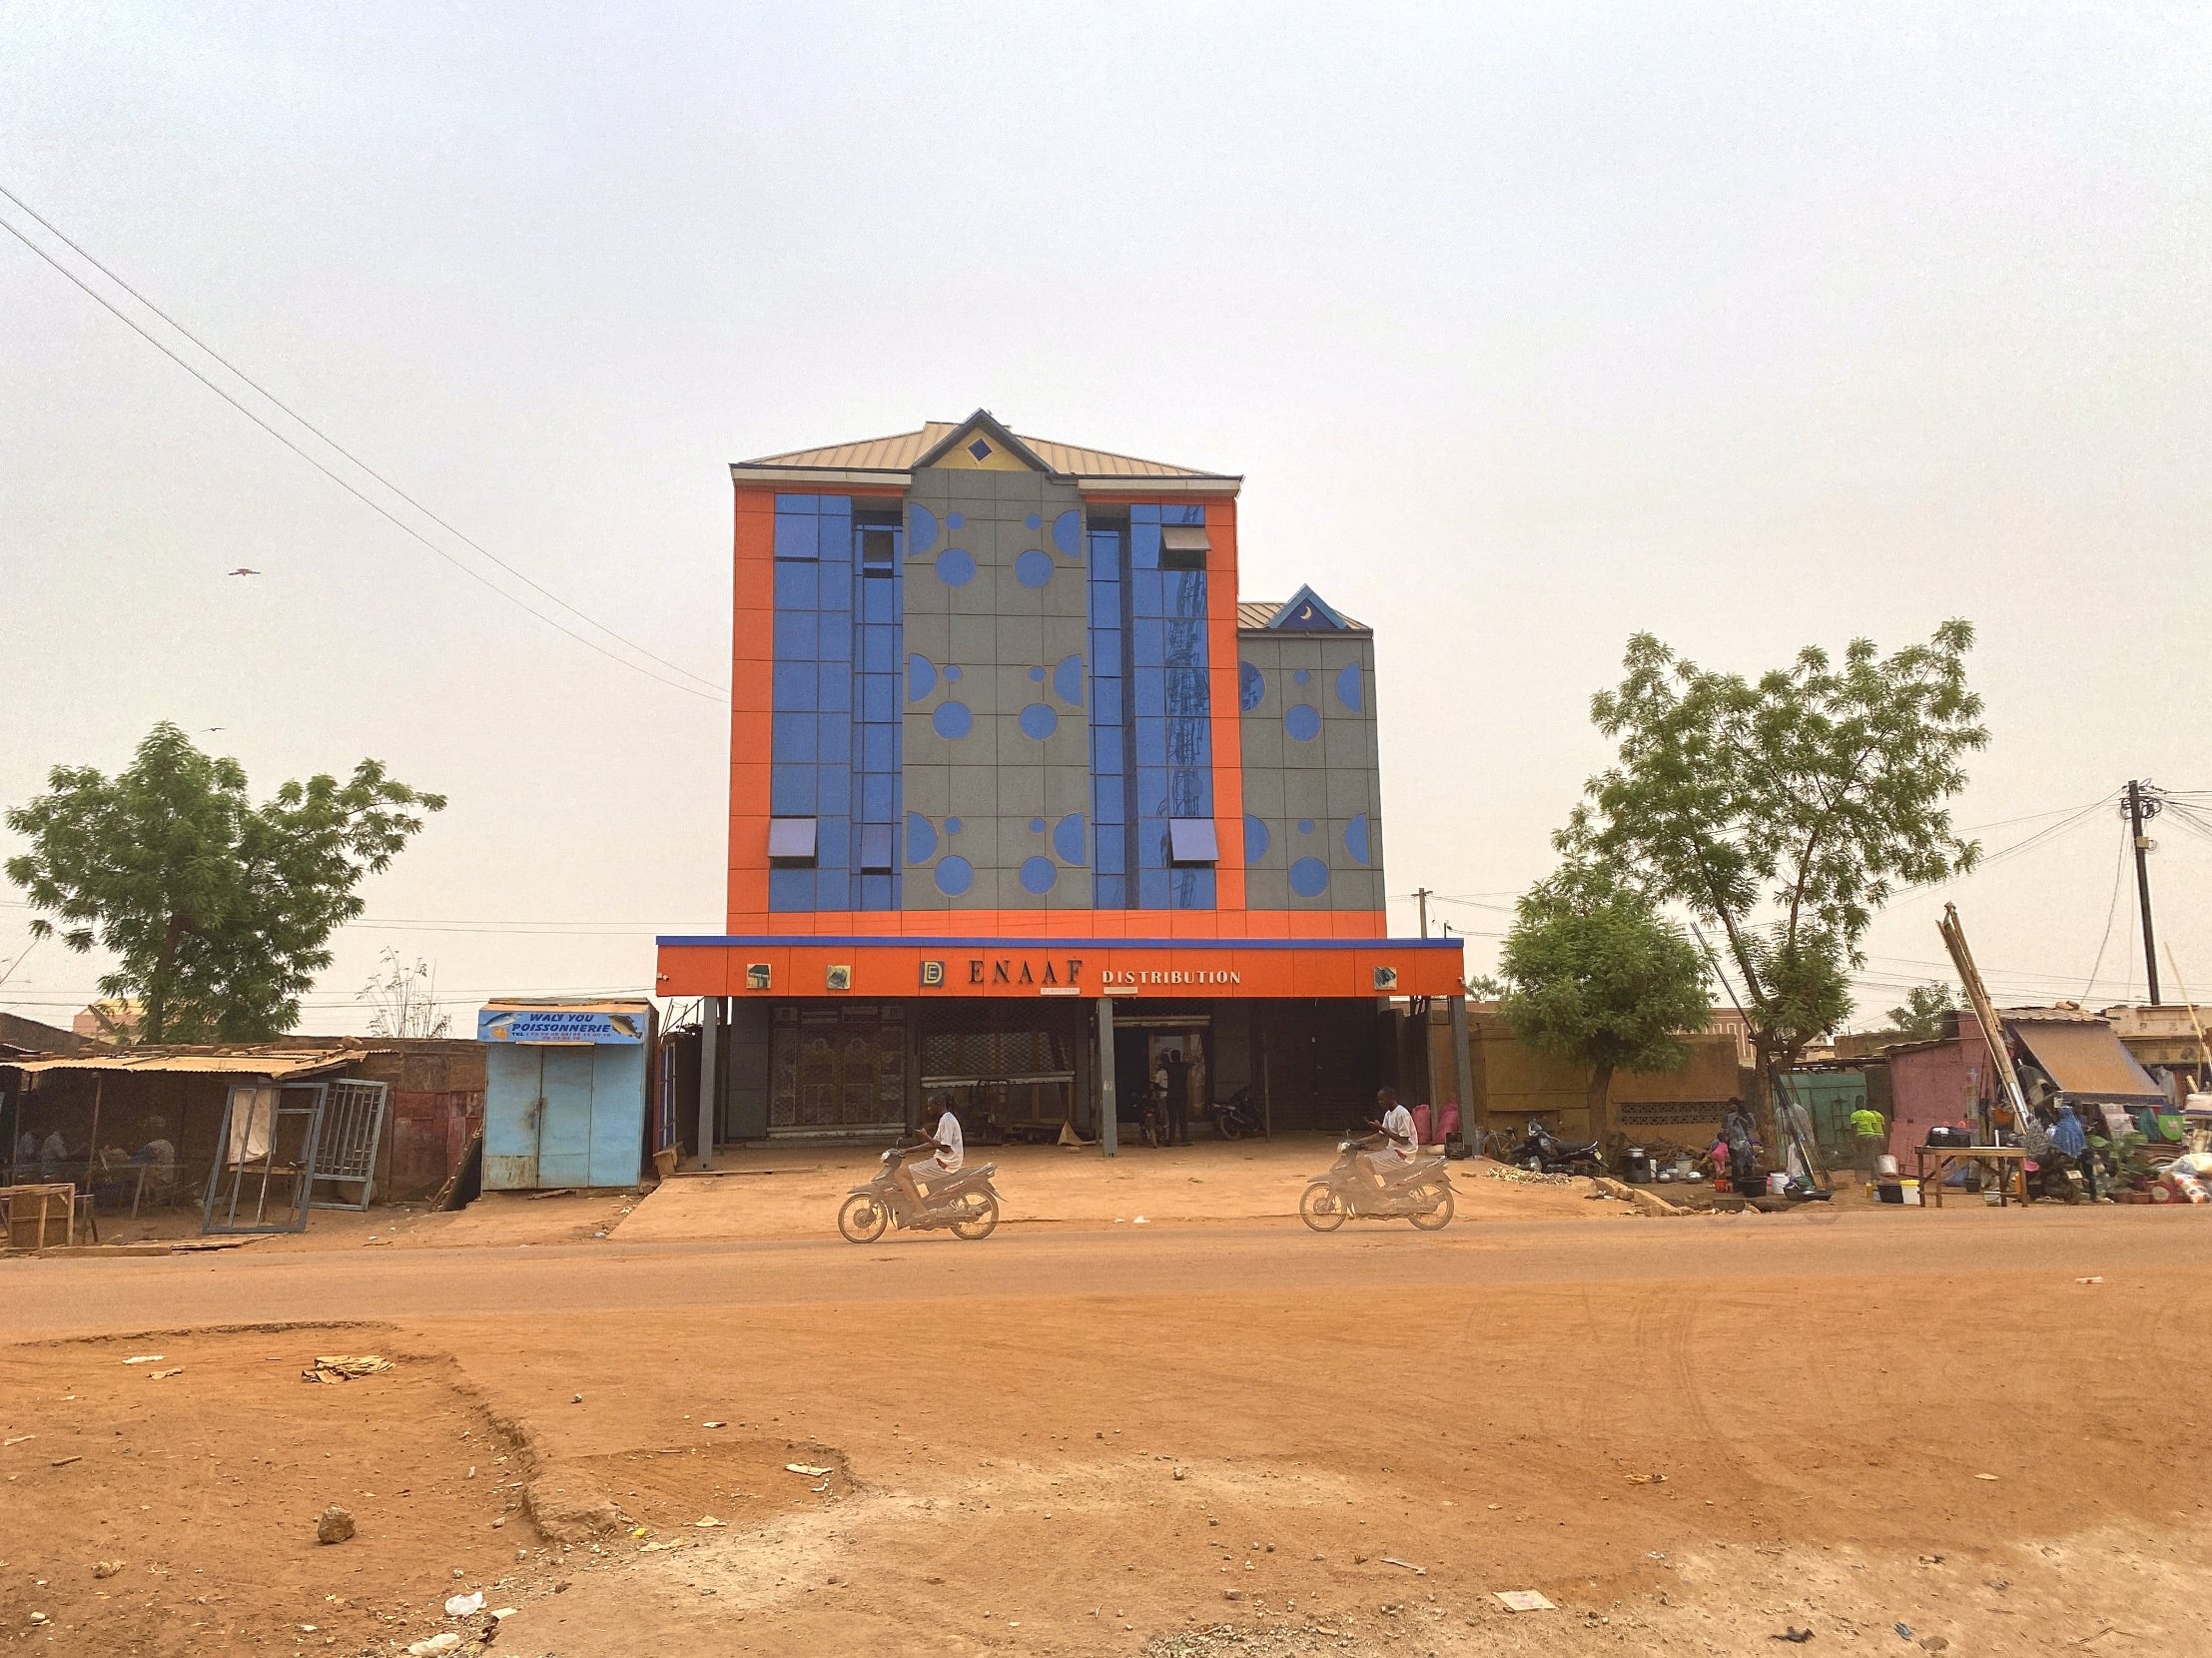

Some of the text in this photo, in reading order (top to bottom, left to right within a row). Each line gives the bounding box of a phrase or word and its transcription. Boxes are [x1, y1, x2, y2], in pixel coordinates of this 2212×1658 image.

[969, 959, 1241, 985] ENAAF DISTRIBUTION
[529, 1013, 595, 1023] WALY YOU
[511, 1023, 612, 1033] POISSONNERIE
